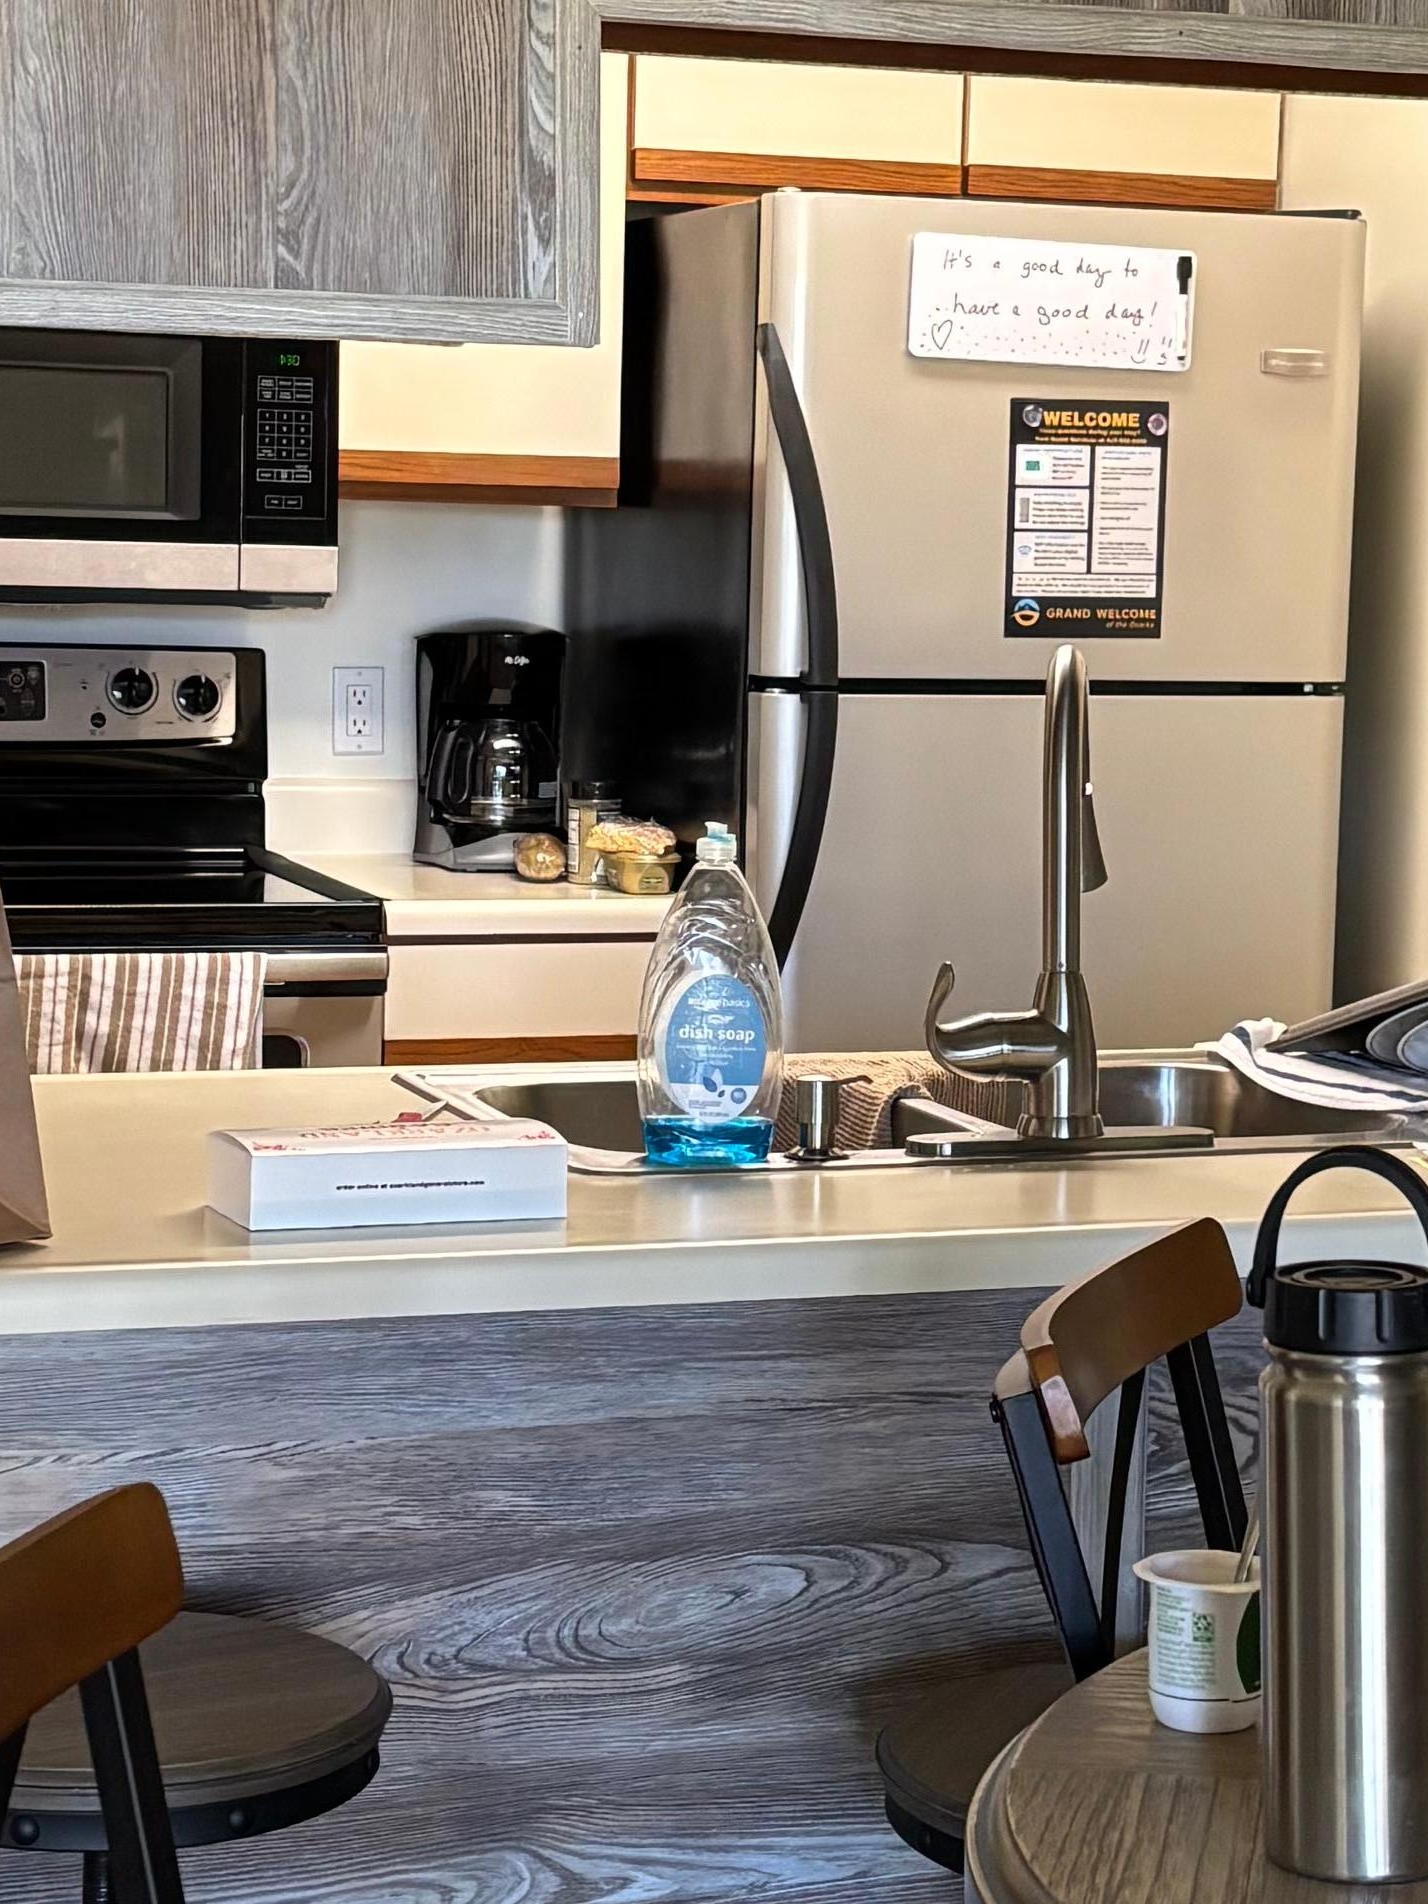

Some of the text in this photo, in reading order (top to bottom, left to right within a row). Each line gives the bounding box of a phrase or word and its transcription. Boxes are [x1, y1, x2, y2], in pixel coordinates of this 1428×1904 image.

[943, 249, 1139, 288] It's a good day to
[953, 293, 1158, 328] have a good day!
[1043, 410, 1141, 428] WELCOME
[1045, 607, 1157, 620] GRAND WELCOME
[678, 1024, 755, 1044] dish soap
